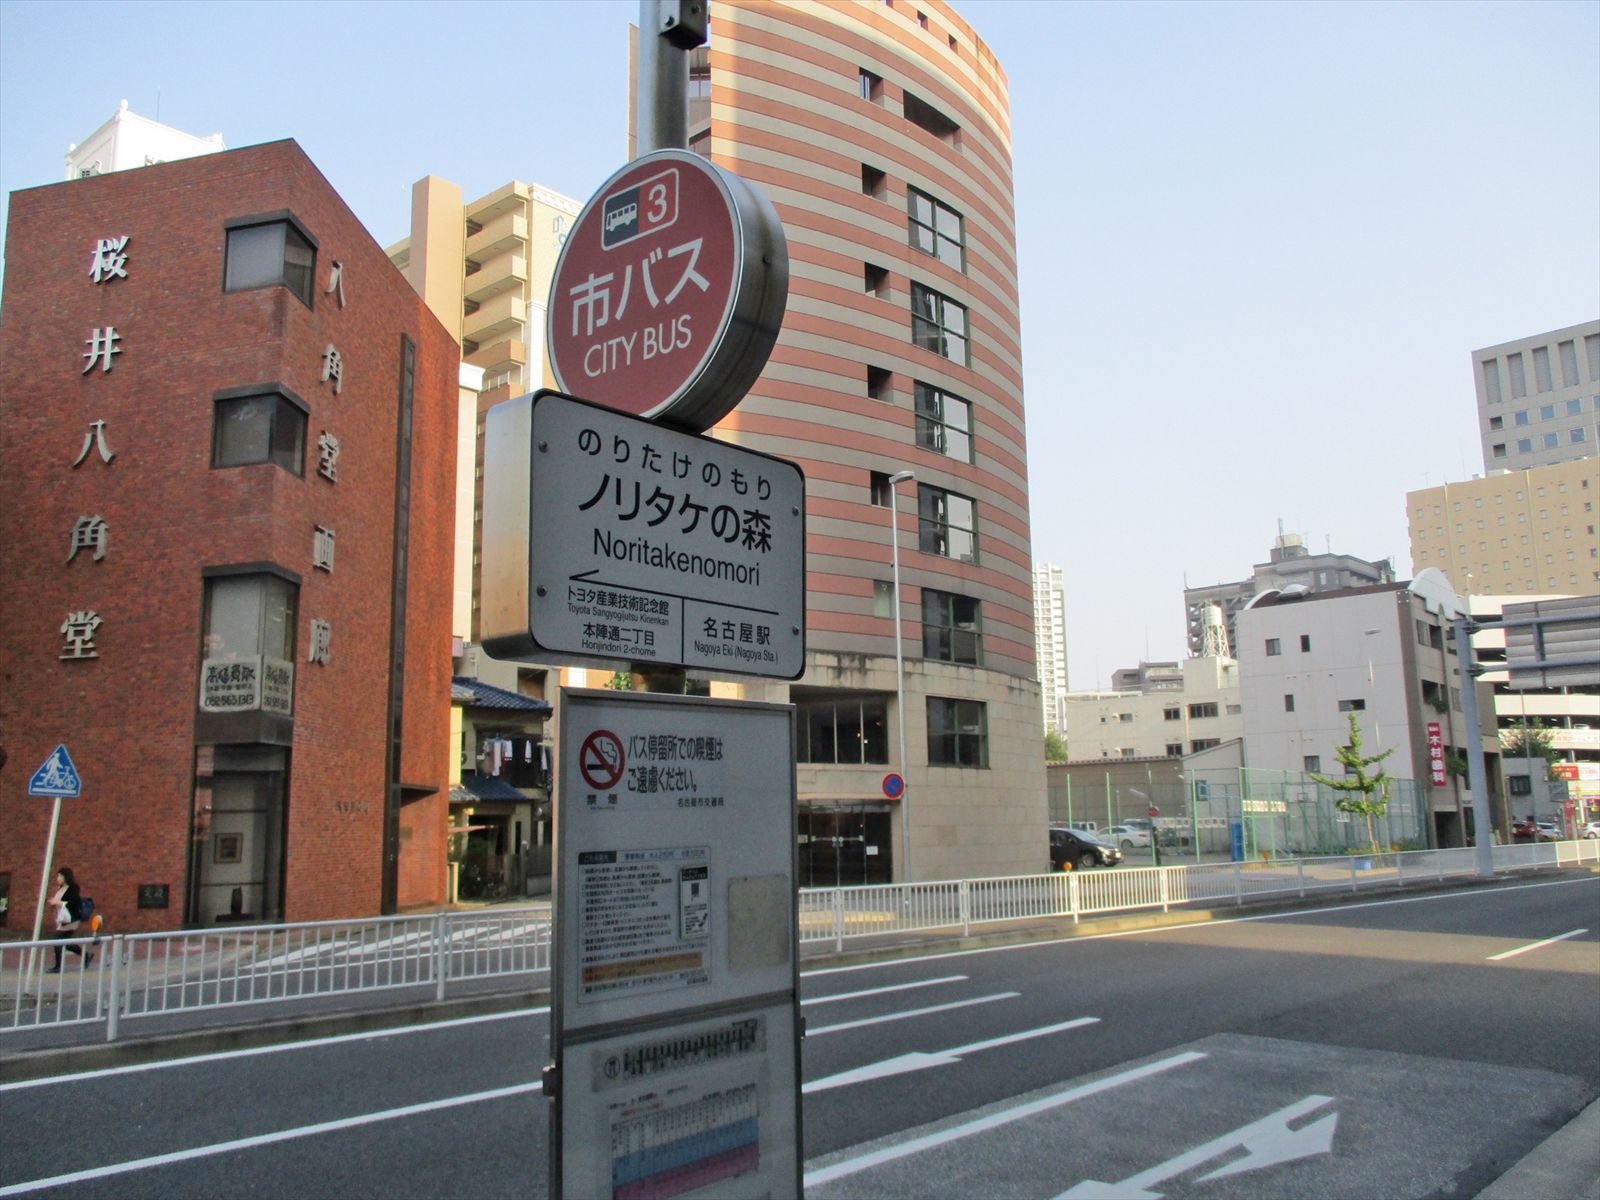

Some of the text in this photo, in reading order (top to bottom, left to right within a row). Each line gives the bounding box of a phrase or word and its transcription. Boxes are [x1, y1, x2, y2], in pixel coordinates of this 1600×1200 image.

[647, 183, 668, 223] 3
[570, 238, 710, 337] 市バス
[583, 314, 693, 378] CITY BUS
[58, 236, 131, 660] 桜井八角堂
[578, 428, 772, 501] のりたけのもり
[578, 473, 772, 554] ノリタケの森
[593, 528, 761, 587] Noritakenomori
[567, 585, 670, 616] トヨタ産業技術記念館
[567, 602, 591, 615] Toyota
[583, 621, 655, 646] 本陣通二丁目
[703, 617, 770, 646] 名古屋駅
[581, 639, 656, 657] Honjindori 2-chome
[694, 640, 721, 657] Nagoya
[722, 644, 734, 656] Eki
[734, 646, 762, 662] (Nagoya
[627, 735, 724, 762] バス停留所での喫煙は
[627, 766, 698, 793] ご遠慮ください。
